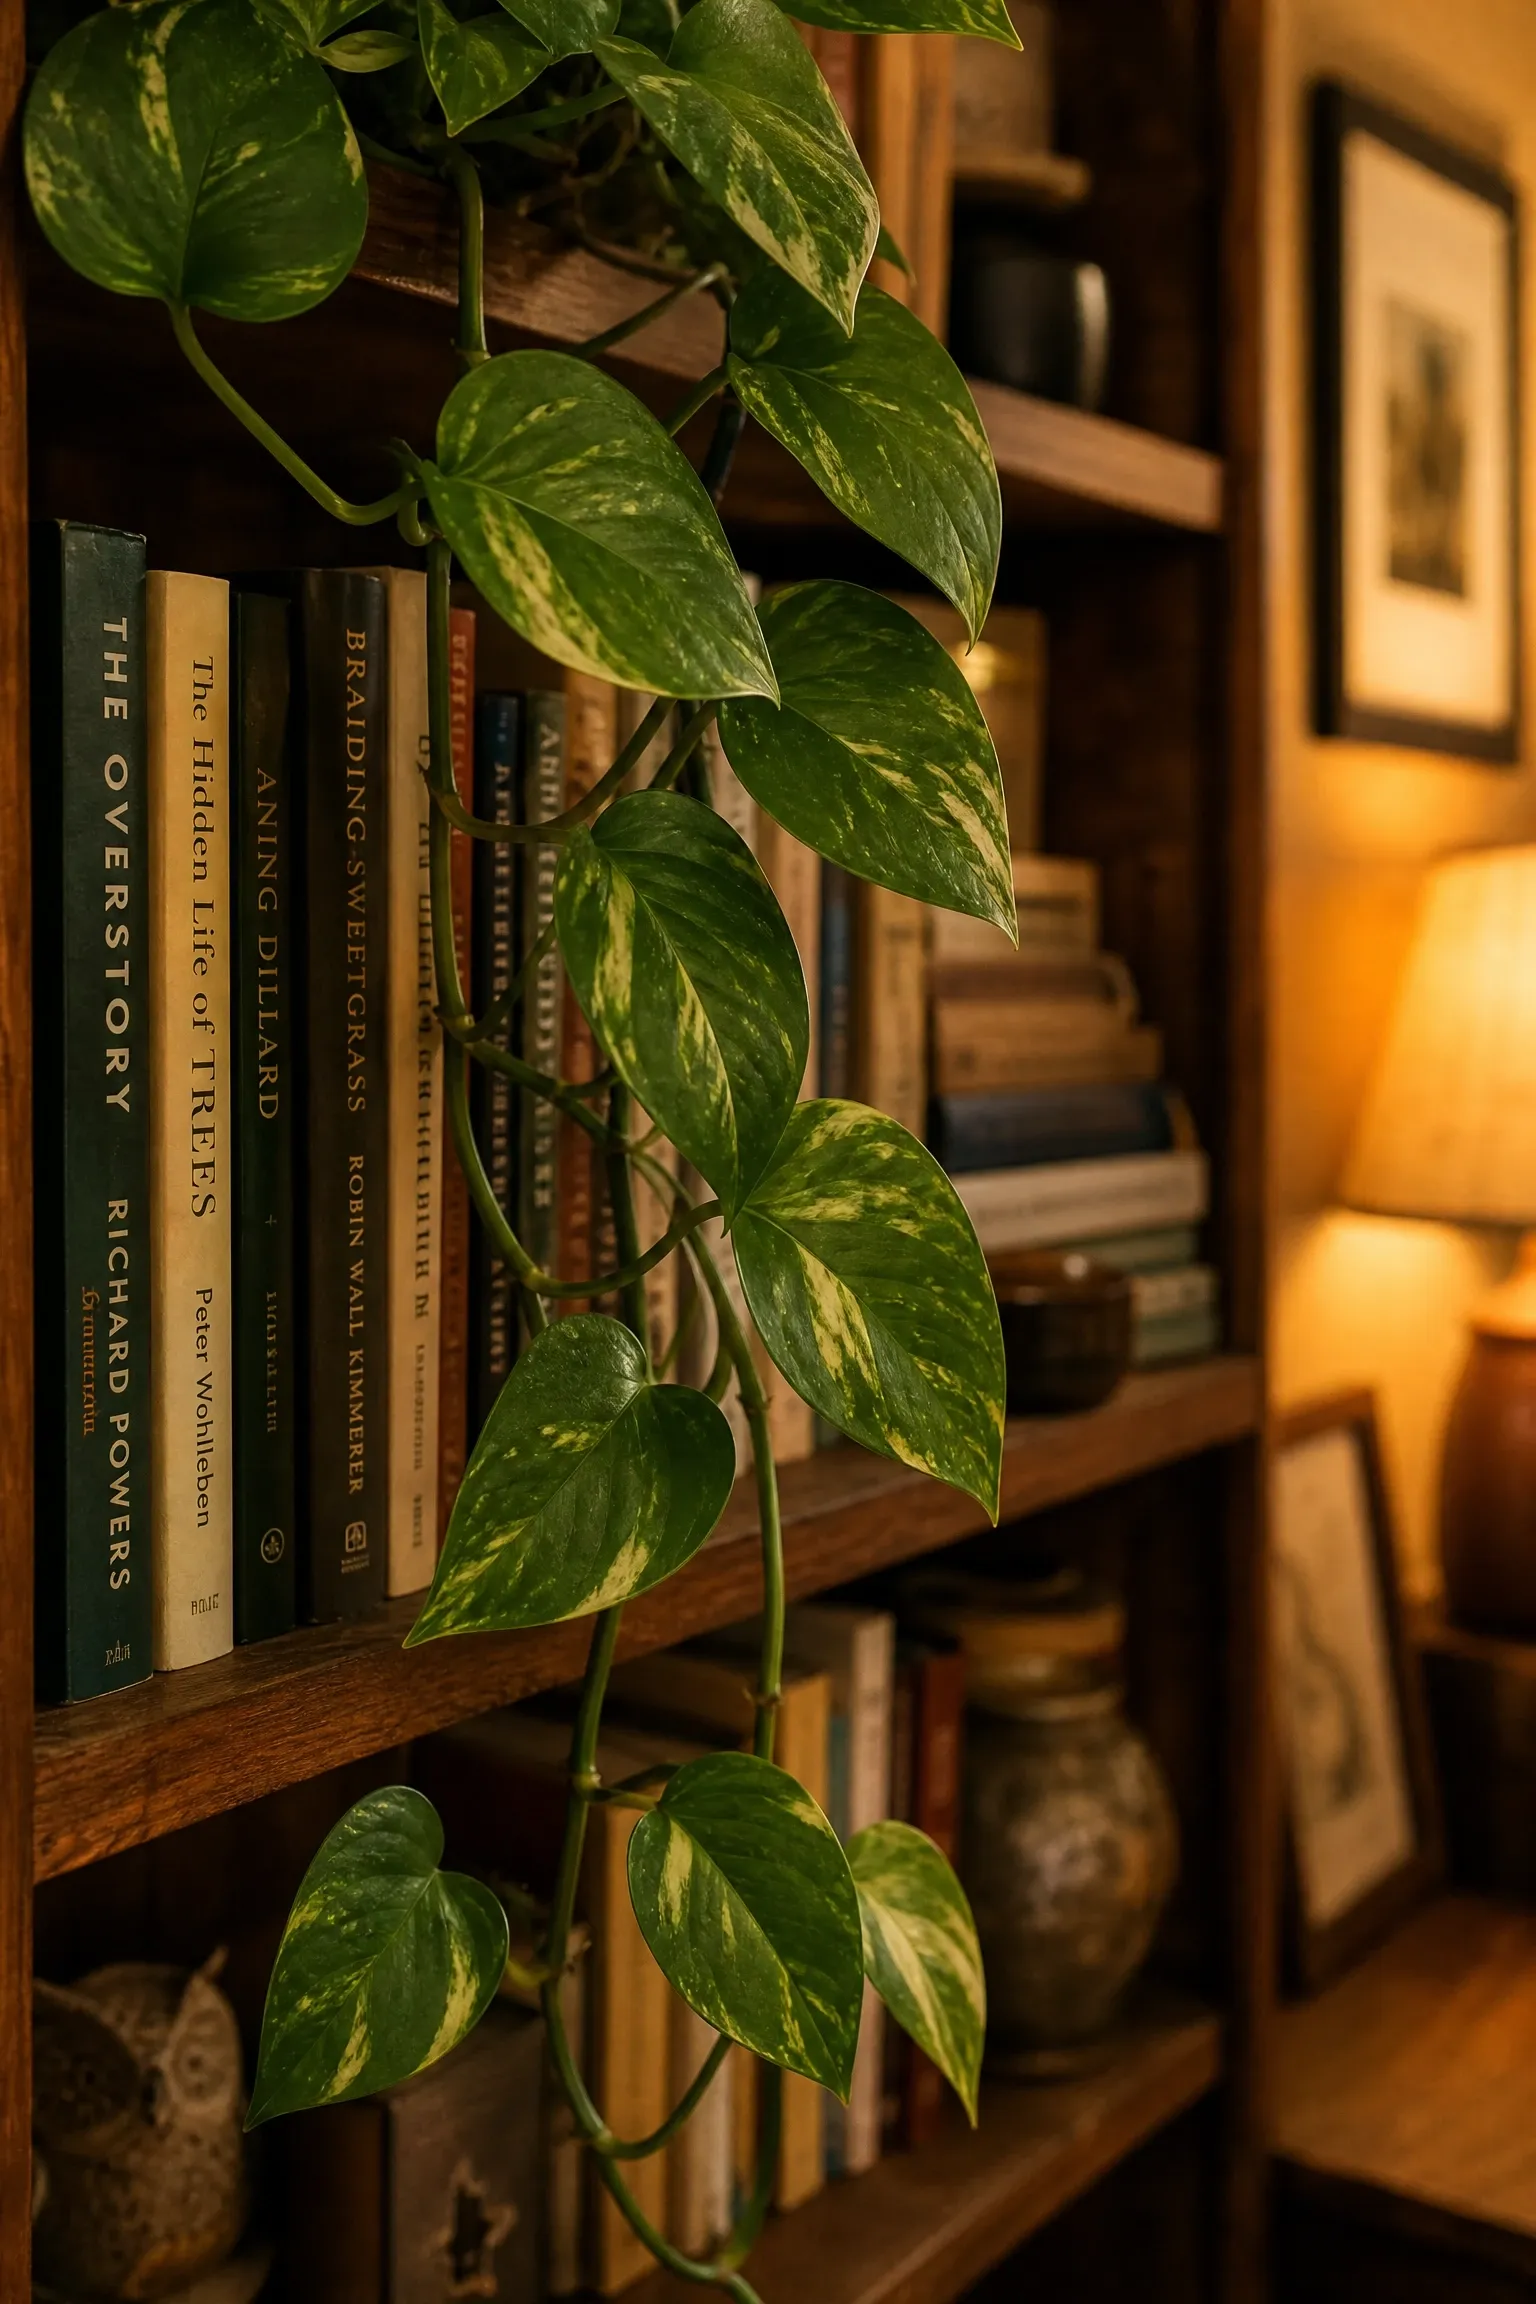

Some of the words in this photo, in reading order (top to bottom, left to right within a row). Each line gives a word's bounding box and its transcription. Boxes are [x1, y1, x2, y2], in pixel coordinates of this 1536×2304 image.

[103, 616, 129, 720] THE
[192, 655, 214, 721] The
[192, 737, 215, 883] Hidden
[257, 767, 278, 912] ANING
[103, 753, 131, 1113] OVERSTORY
[191, 898, 216, 976] Life
[191, 992, 216, 1035] of
[258, 934, 279, 1119] DILLARD
[190, 1048, 217, 1218] TREES
[348, 1155, 364, 1247] ROBIN
[107, 1198, 130, 1394] RICHARD
[195, 1287, 213, 1362] Peter
[349, 1259, 365, 1337] WALL
[196, 1371, 214, 1528] Wohlleben
[348, 1348, 365, 1495] KIMMERER
[109, 1412, 131, 1590] POWERS
